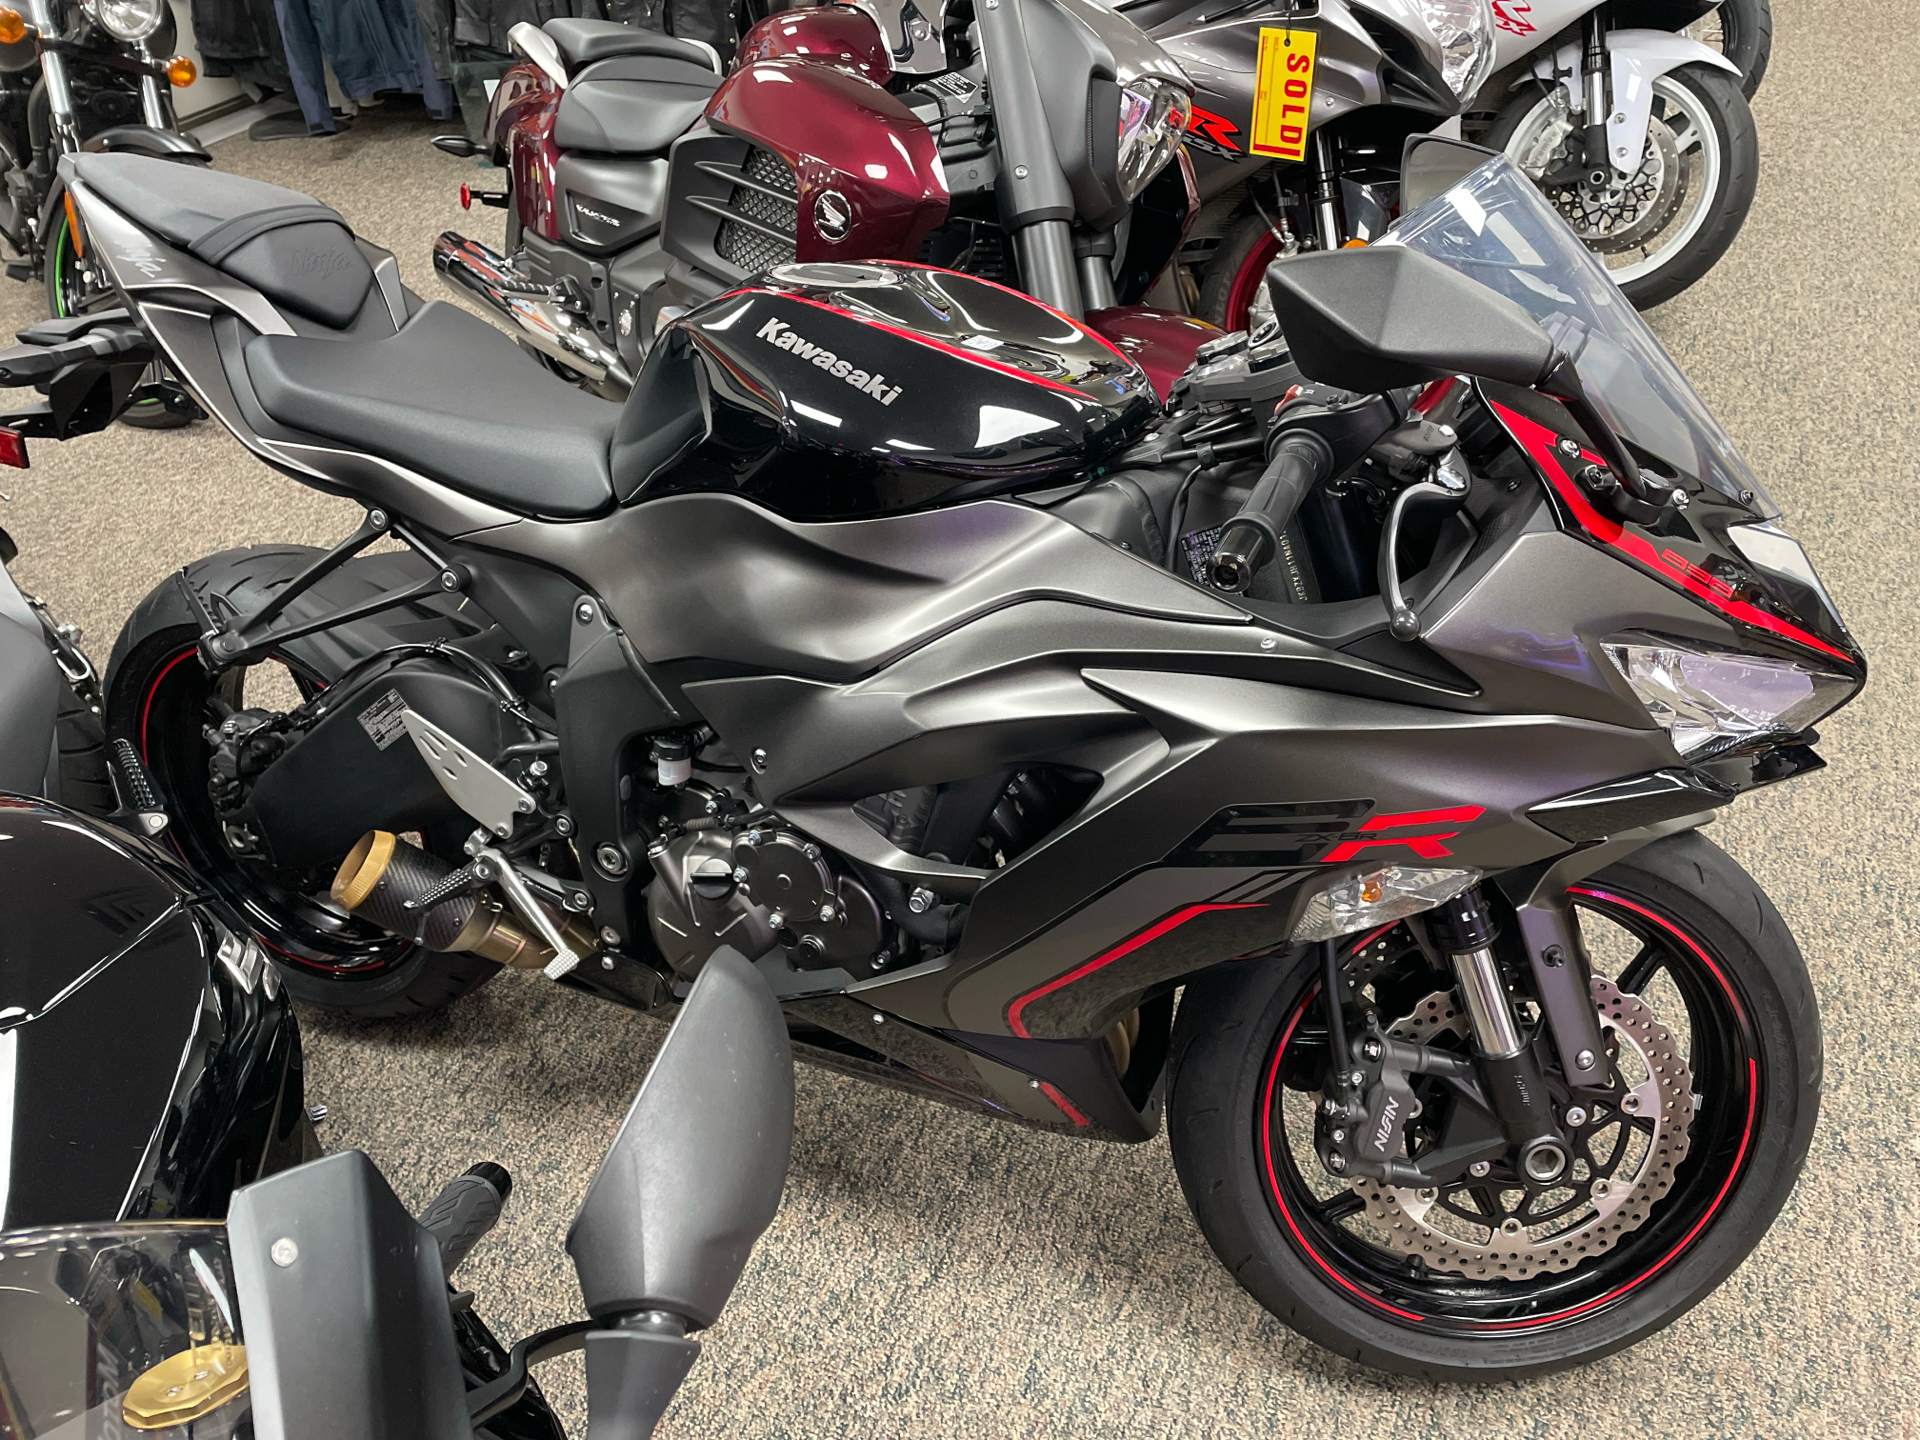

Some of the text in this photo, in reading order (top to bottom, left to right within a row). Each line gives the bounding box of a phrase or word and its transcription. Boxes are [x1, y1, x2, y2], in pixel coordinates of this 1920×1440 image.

[1280, 53, 1310, 144] SOLD
[291, 245, 355, 281] Ninja
[756, 316, 903, 407] Kawasaki
[1293, 832, 1378, 842] ZX-6R
[1374, 1095, 1399, 1152] NISSIN
